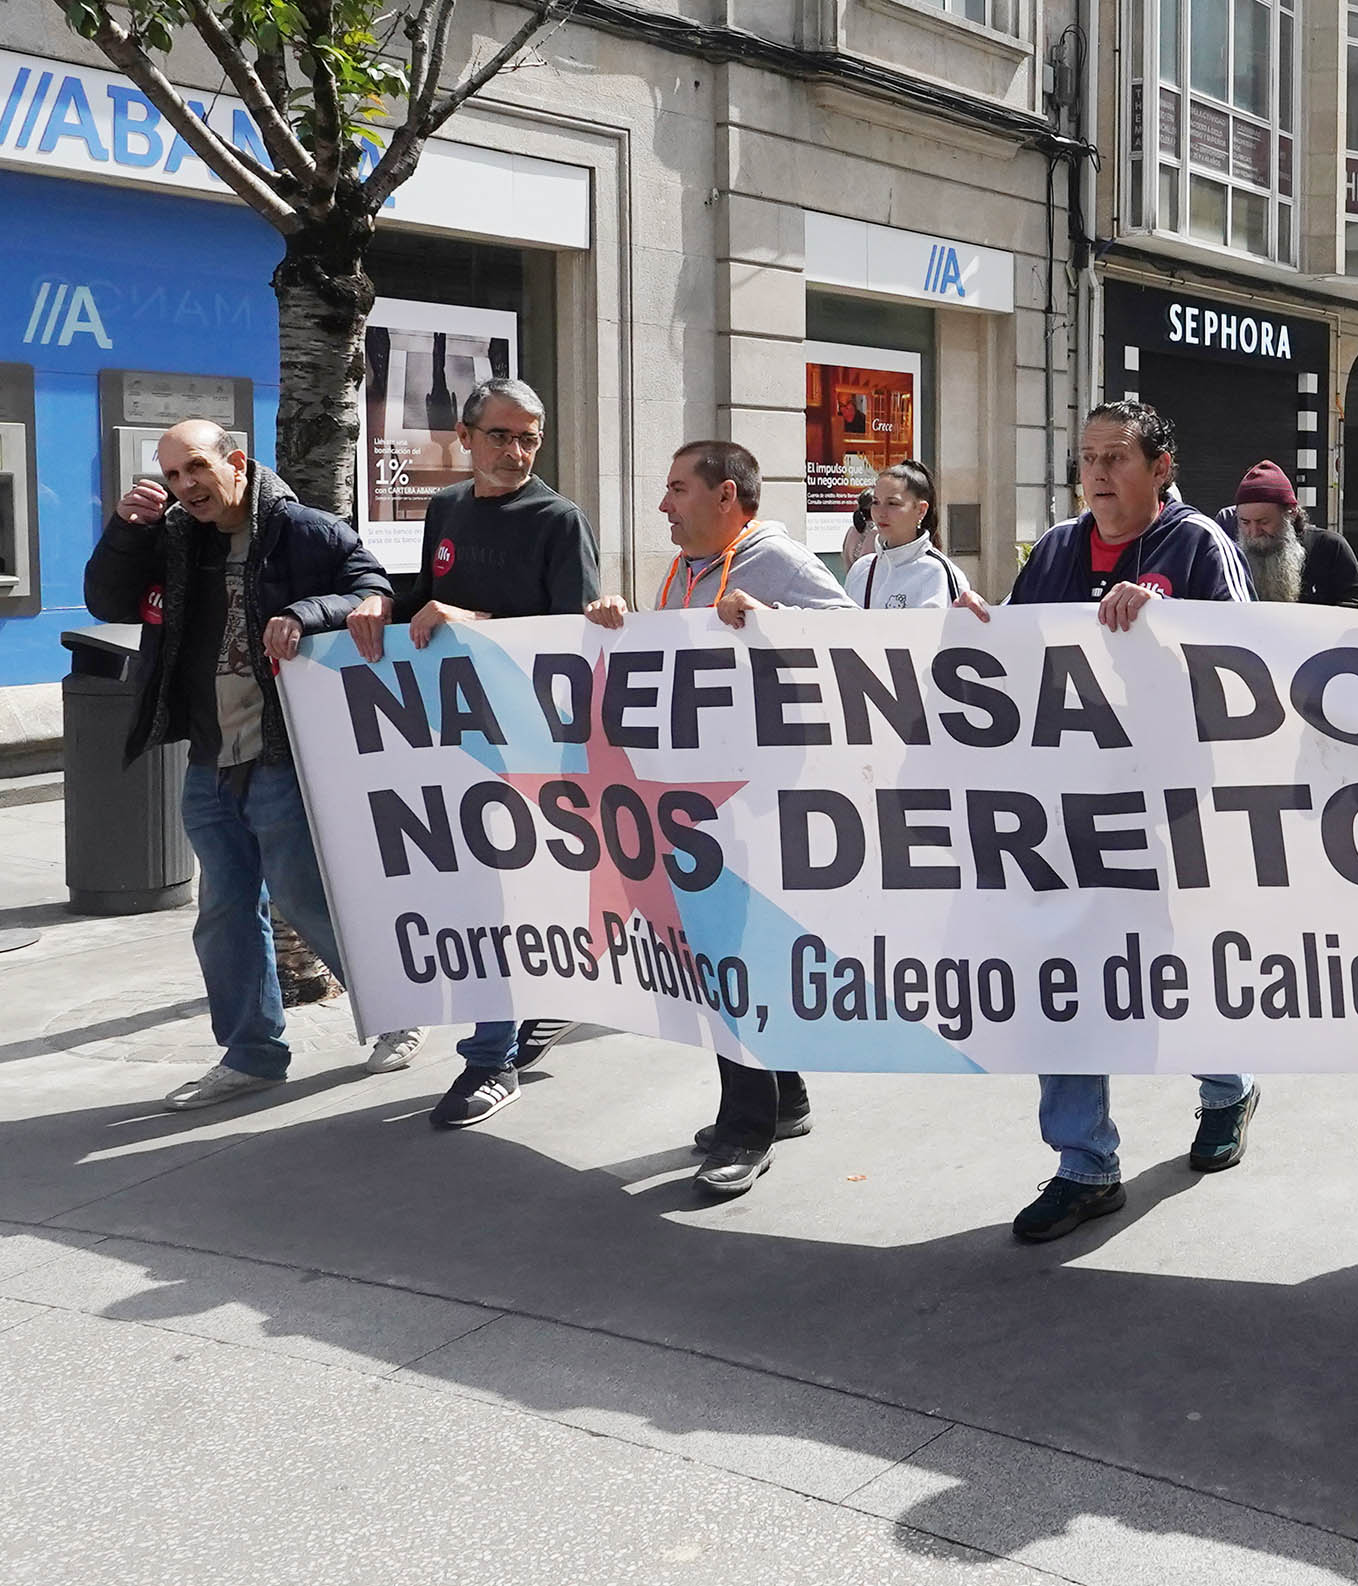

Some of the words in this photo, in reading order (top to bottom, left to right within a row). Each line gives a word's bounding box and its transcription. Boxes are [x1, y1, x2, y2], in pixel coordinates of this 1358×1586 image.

[1169, 304, 1291, 359] SEPHORA
[872, 418, 893, 432] Crece
[411, 447, 421, 455] del
[807, 462, 815, 474] El
[816, 463, 846, 477] impulso
[807, 475, 816, 486] tu
[817, 476, 848, 488] negocio
[850, 477, 877, 487] necesit
[339, 656, 508, 755] NA
[532, 645, 1133, 750] DEFENSA
[367, 780, 724, 893] NOSOS
[395, 912, 600, 984] Correos
[603, 910, 769, 1033] Público,
[791, 934, 1016, 1041] Galego
[1038, 957, 1079, 1022] e
[1103, 932, 1189, 1021] de
